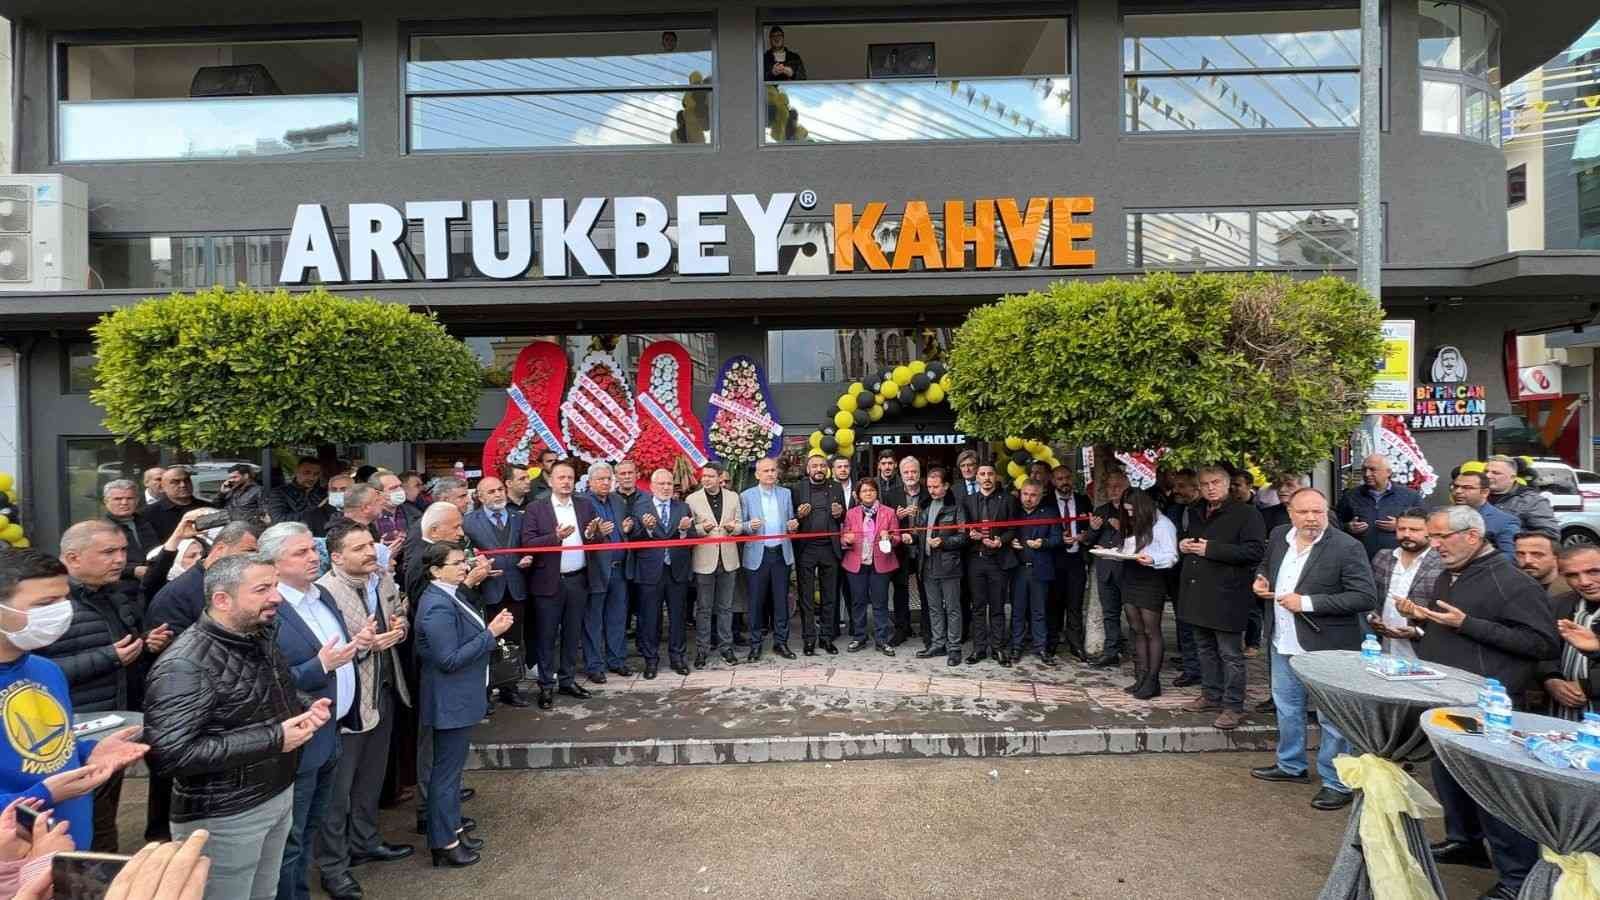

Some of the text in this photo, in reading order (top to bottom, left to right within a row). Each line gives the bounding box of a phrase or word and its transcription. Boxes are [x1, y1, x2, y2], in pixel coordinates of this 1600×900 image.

[279, 192, 797, 284] ARTUKBEY
[833, 196, 1096, 272] KAHVE
[1416, 400, 1486, 415] HEYECAN
[1412, 414, 1486, 428] #ARTUKBEY
